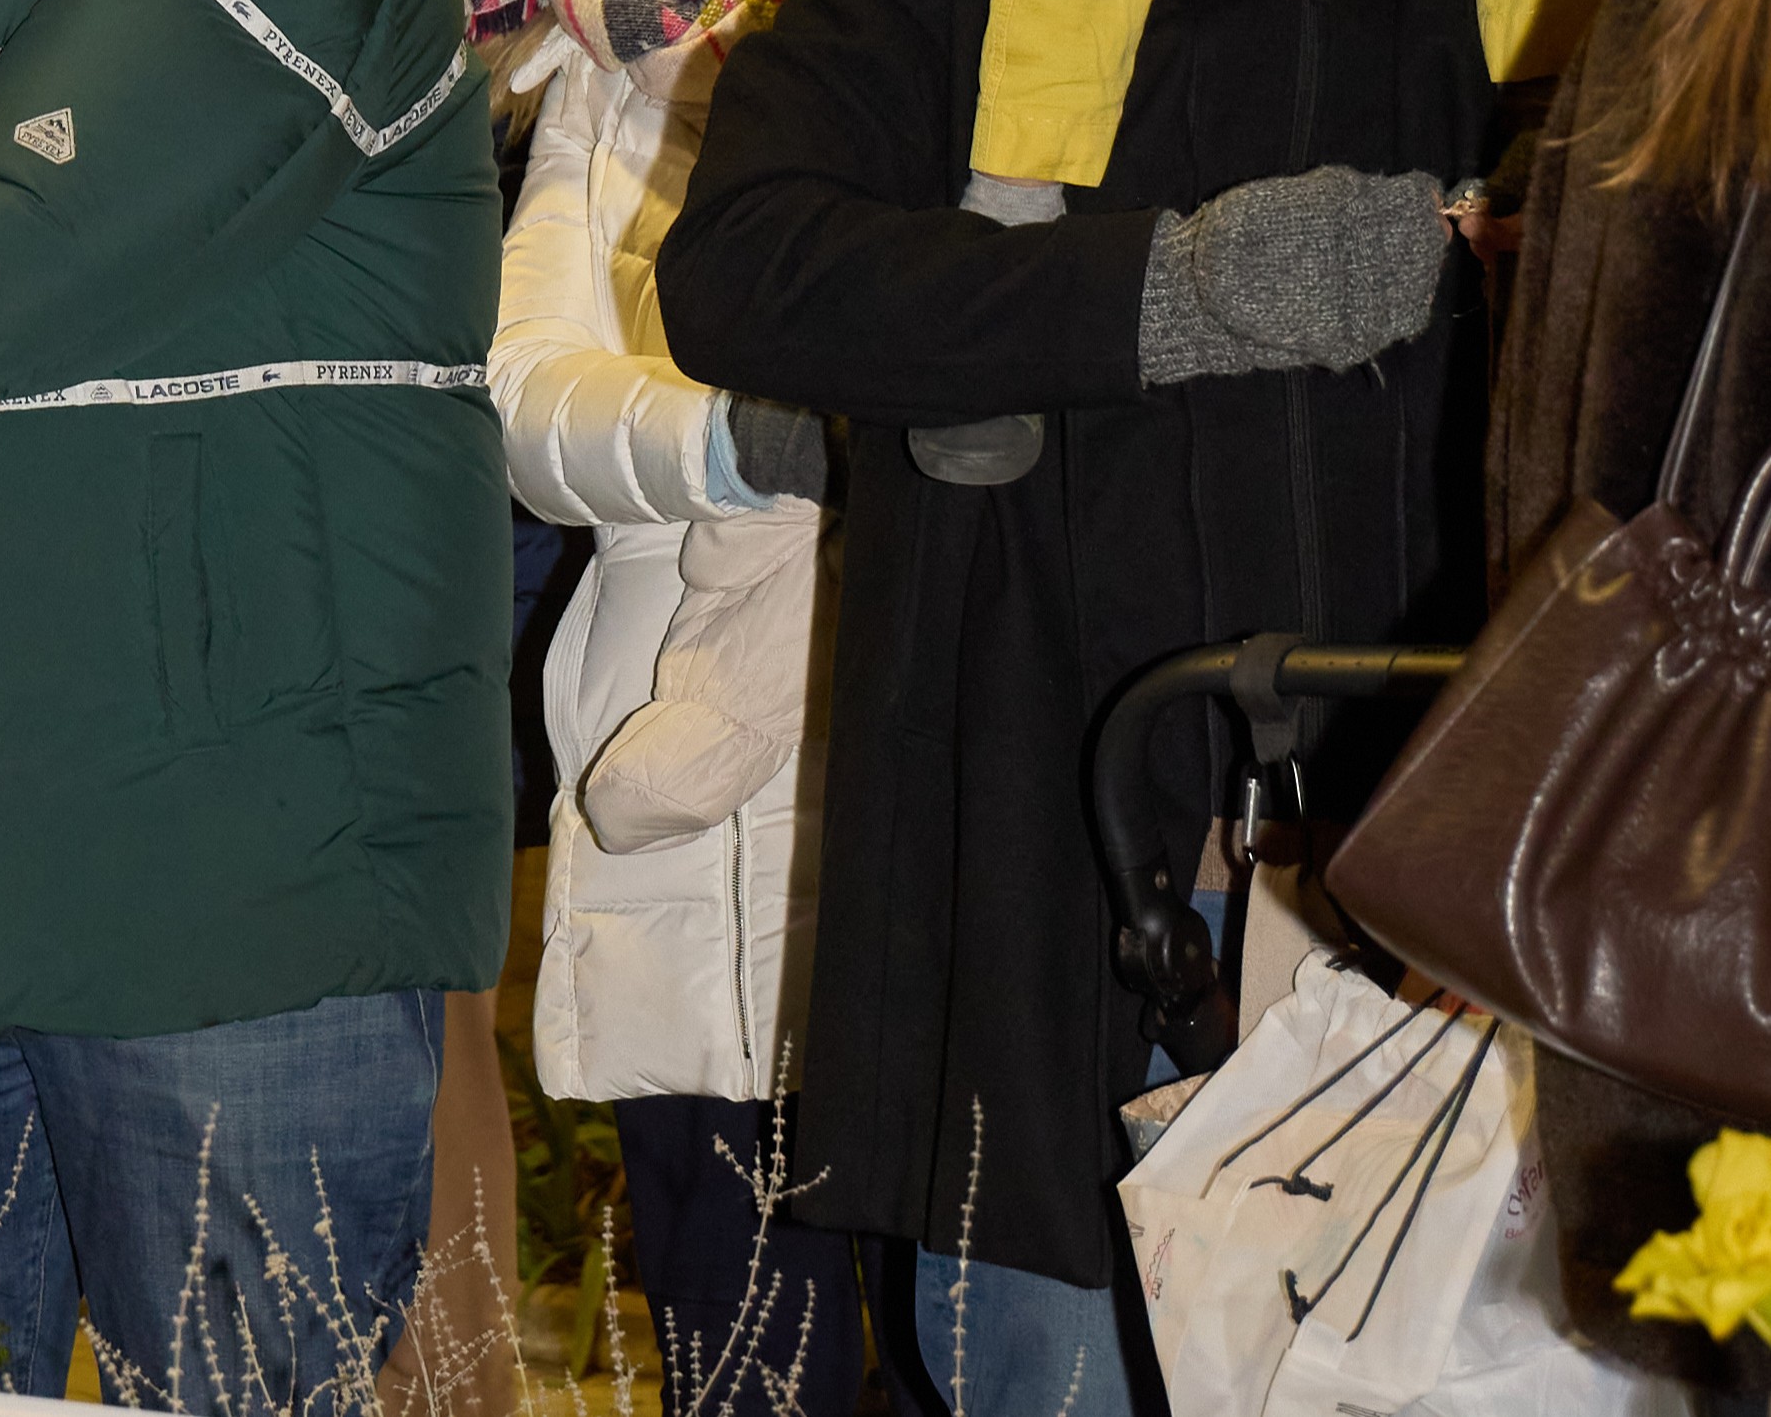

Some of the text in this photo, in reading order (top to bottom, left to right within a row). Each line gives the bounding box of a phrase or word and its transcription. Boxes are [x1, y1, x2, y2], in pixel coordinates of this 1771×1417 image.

[263, 28, 338, 99] PYRENEX
[135, 374, 241, 400] LACOSTE
[317, 365, 394, 380] PYRENEX
